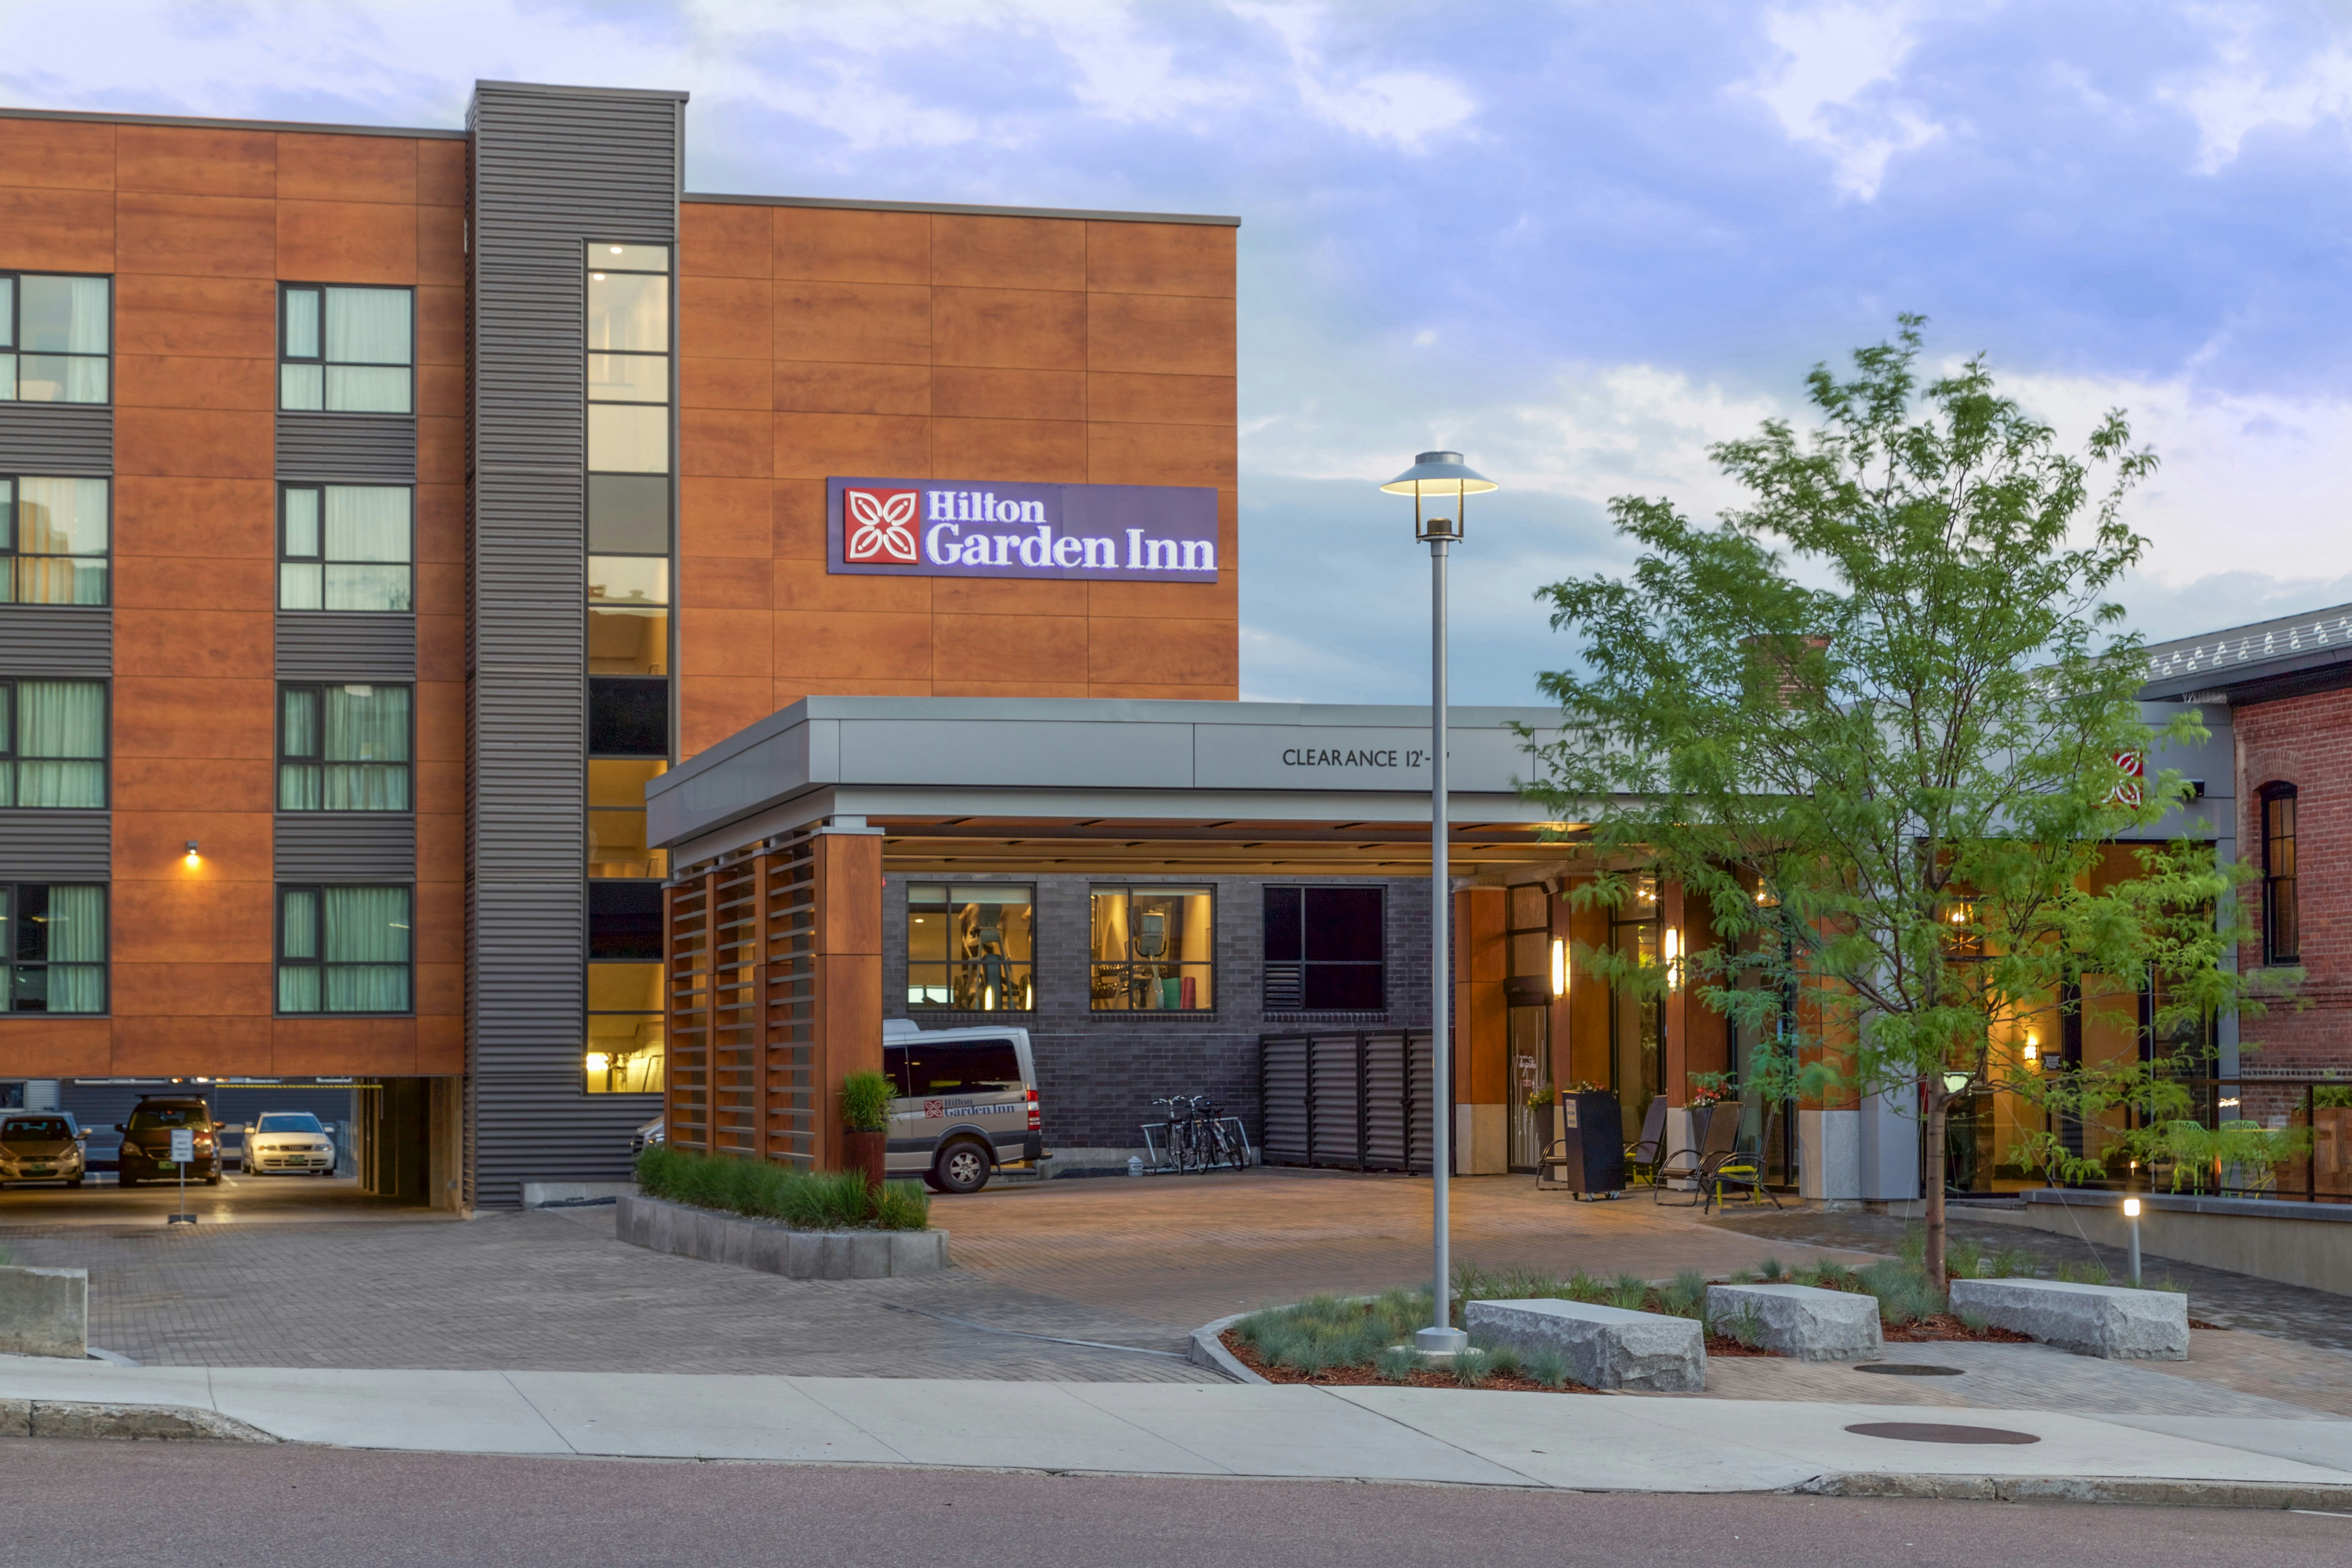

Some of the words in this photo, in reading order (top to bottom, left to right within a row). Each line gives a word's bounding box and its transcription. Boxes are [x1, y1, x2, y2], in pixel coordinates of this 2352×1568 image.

[926, 490, 1047, 523] Hilton
[925, 522, 1119, 568] Garden
[1124, 528, 1218, 571] Inn
[1283, 749, 1397, 767] CLEARANCE
[944, 1105, 991, 1117] Garden
[992, 1104, 1014, 1114] Inn
[945, 1099, 973, 1107] Hilton
